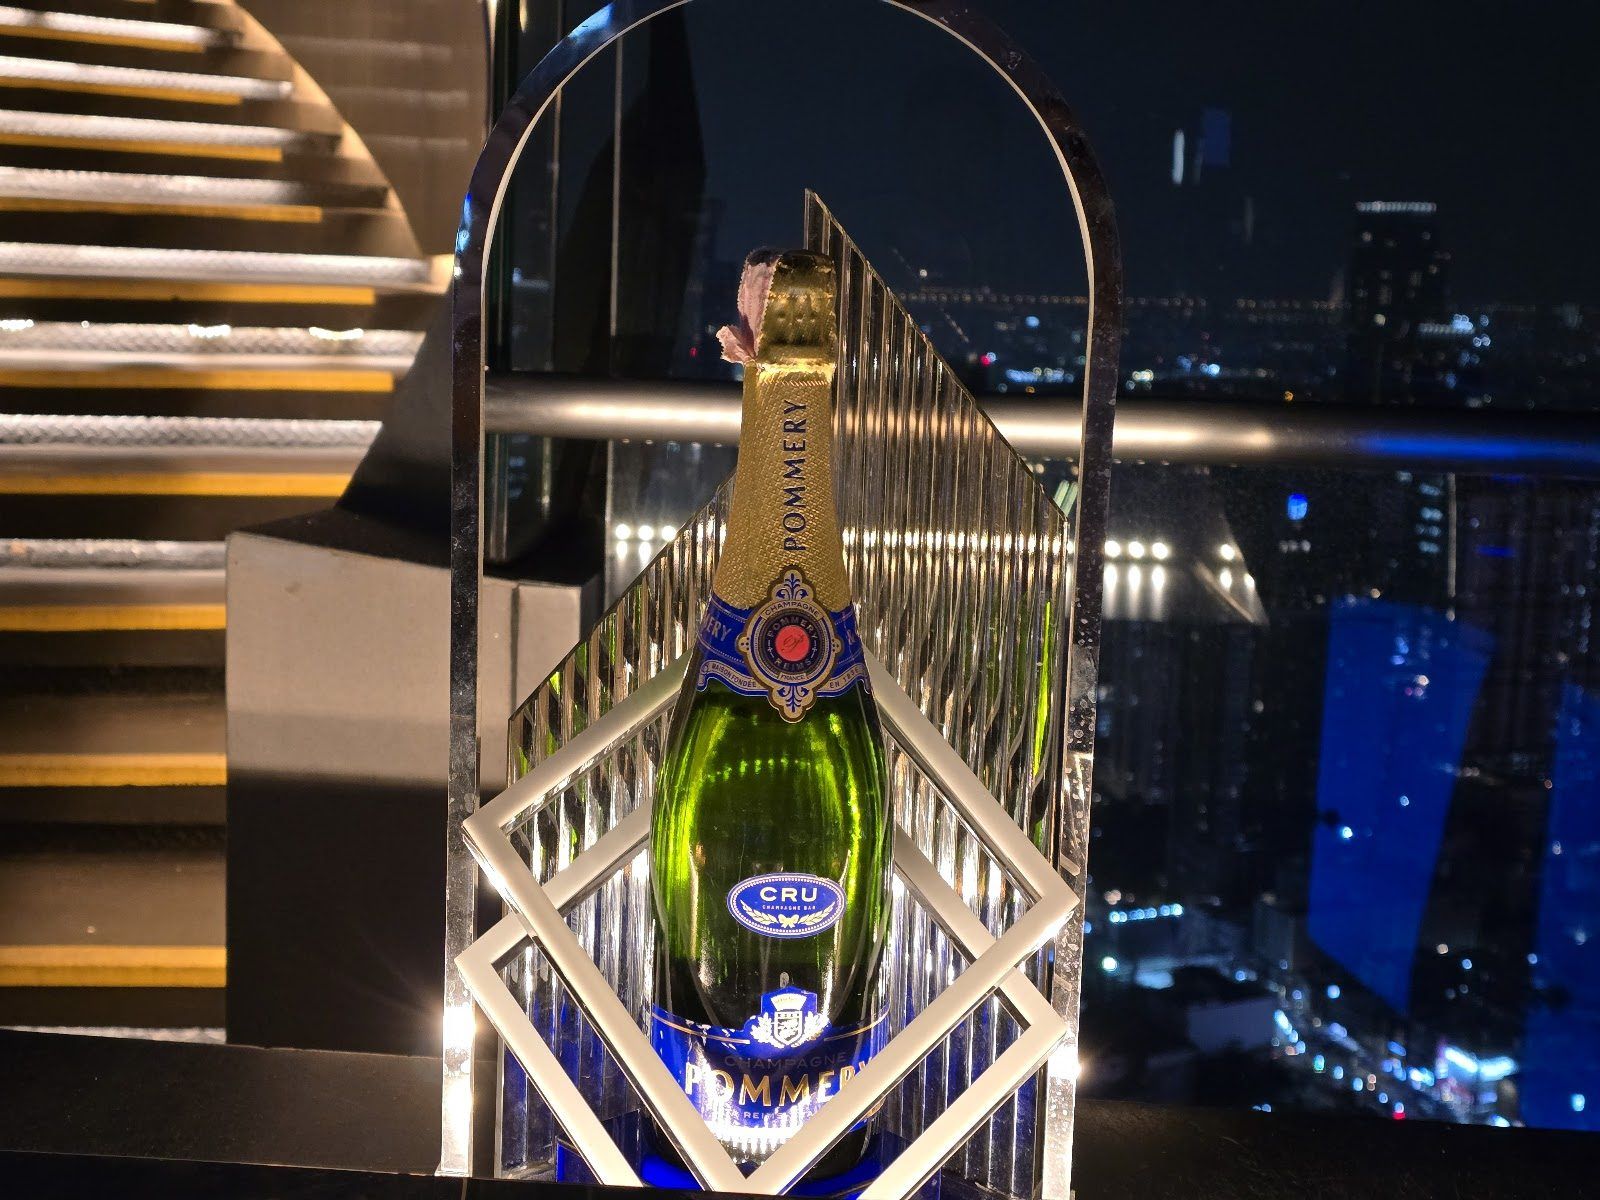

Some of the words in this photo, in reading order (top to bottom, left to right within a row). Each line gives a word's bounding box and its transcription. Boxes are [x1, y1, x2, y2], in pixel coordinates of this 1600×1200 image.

[783, 400, 807, 551] POMMERY
[765, 601, 820, 616] CHAMPAGNE
[767, 616, 818, 639] POMMERY
[712, 663, 732, 678] MAISON
[775, 657, 812, 671] REIMS
[780, 673, 805, 681] FRANCE
[830, 681, 840, 689] EN
[760, 886, 818, 903] CRU
[724, 1051, 848, 1069] CHAMPAGNE
